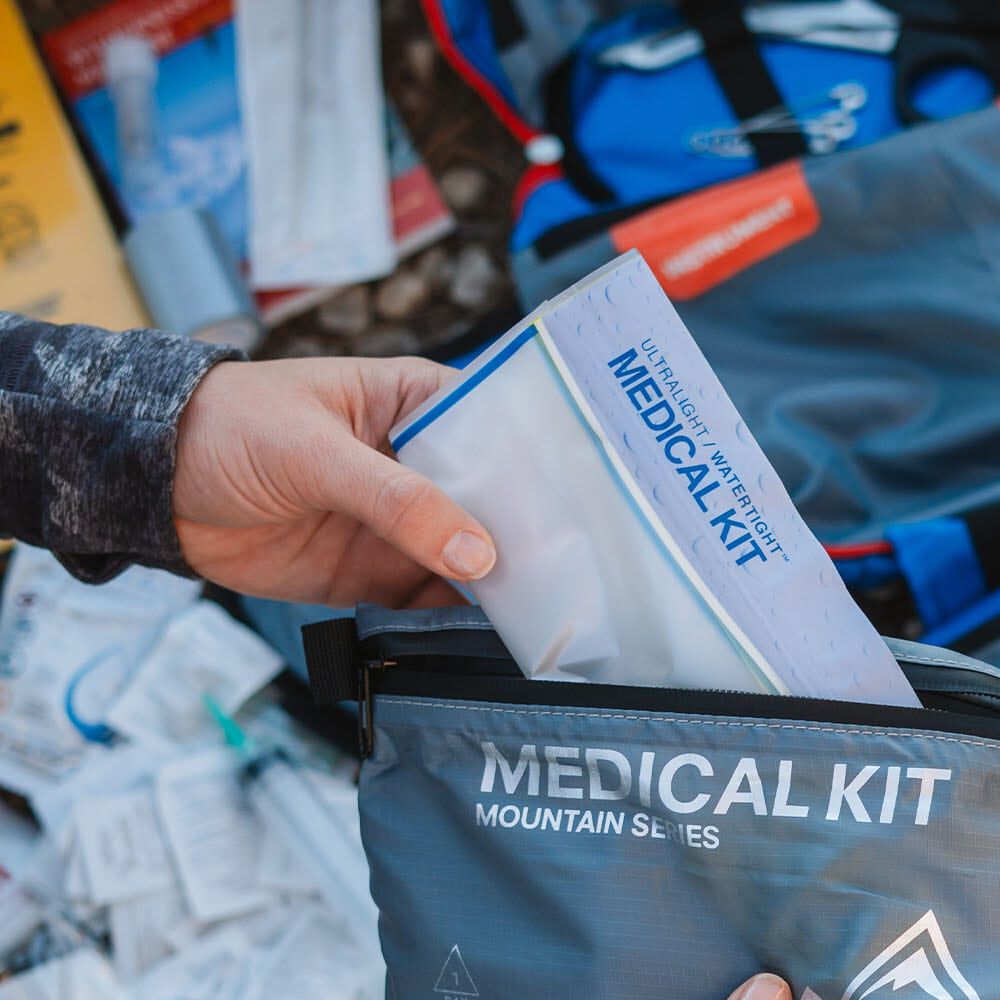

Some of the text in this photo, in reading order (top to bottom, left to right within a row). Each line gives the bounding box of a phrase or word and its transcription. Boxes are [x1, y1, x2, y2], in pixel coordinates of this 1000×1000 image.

[641, 337, 710, 438] ULTRALIGHT
[607, 347, 768, 566] MEDICAL KIT
[475, 803, 720, 850] MOUNTAIN SERIES
[480, 741, 952, 826] MEDICAL KIT
